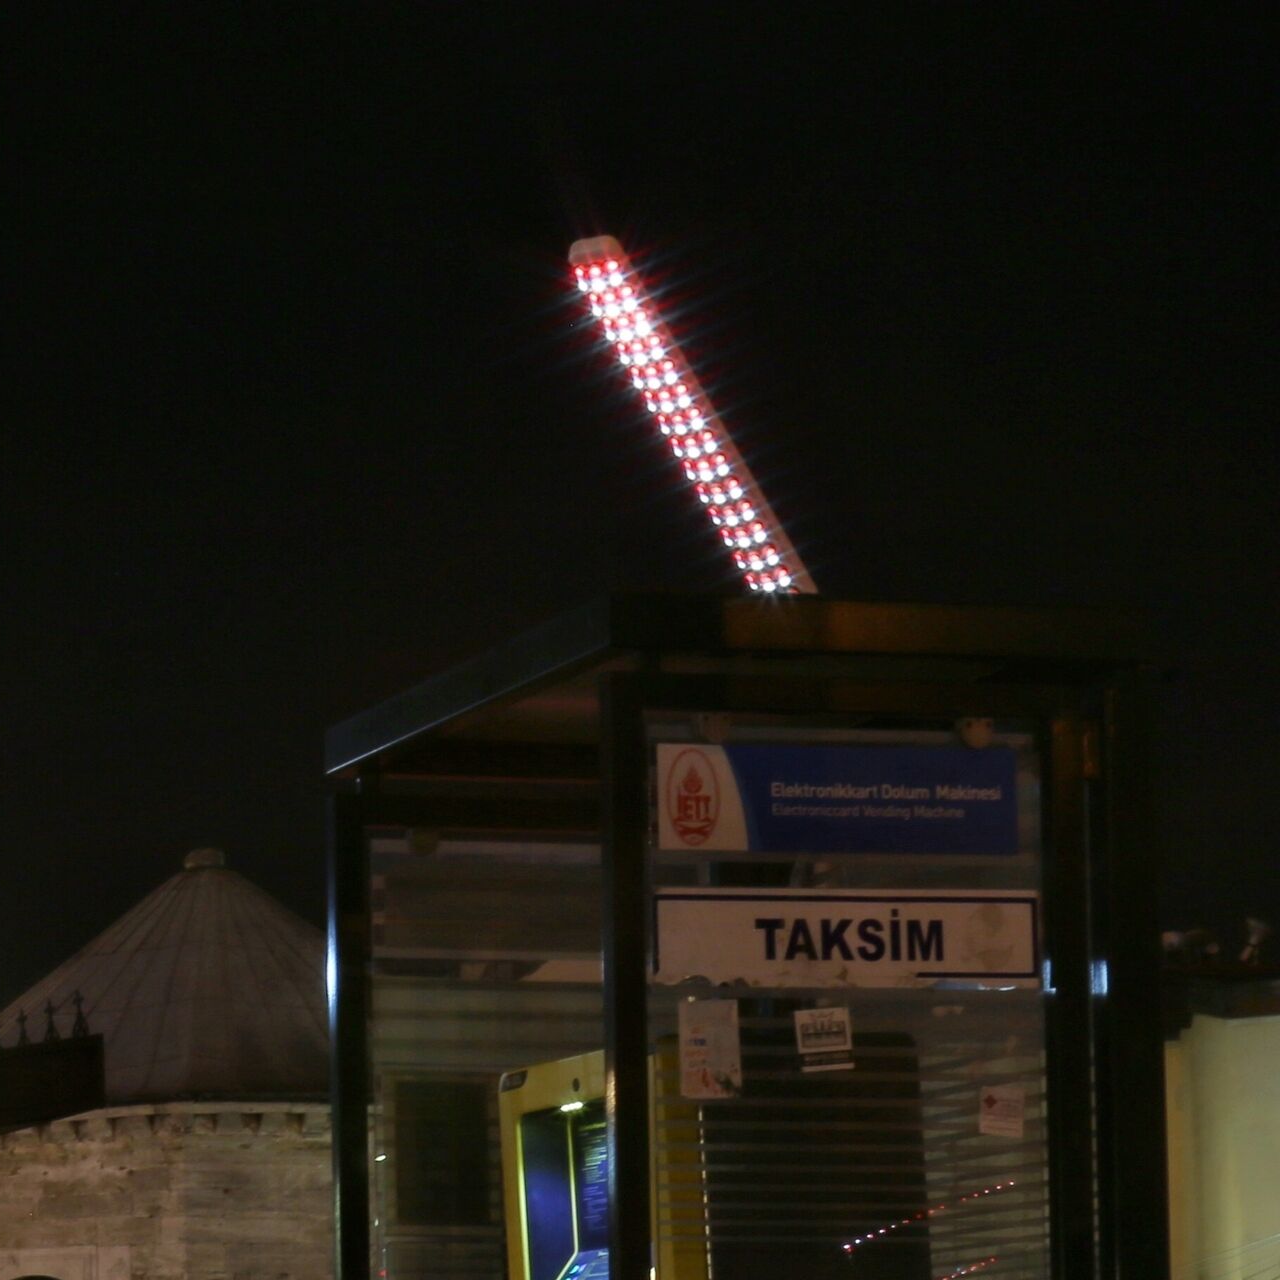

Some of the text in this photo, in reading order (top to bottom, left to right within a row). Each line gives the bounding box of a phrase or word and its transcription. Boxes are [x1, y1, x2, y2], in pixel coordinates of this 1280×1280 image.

[771, 782, 1002, 802] Elektronikkart Dolum Makinesi
[862, 804, 911, 821] Vending
[914, 805, 965, 819] Machine
[755, 908, 944, 961] TAKSİM
